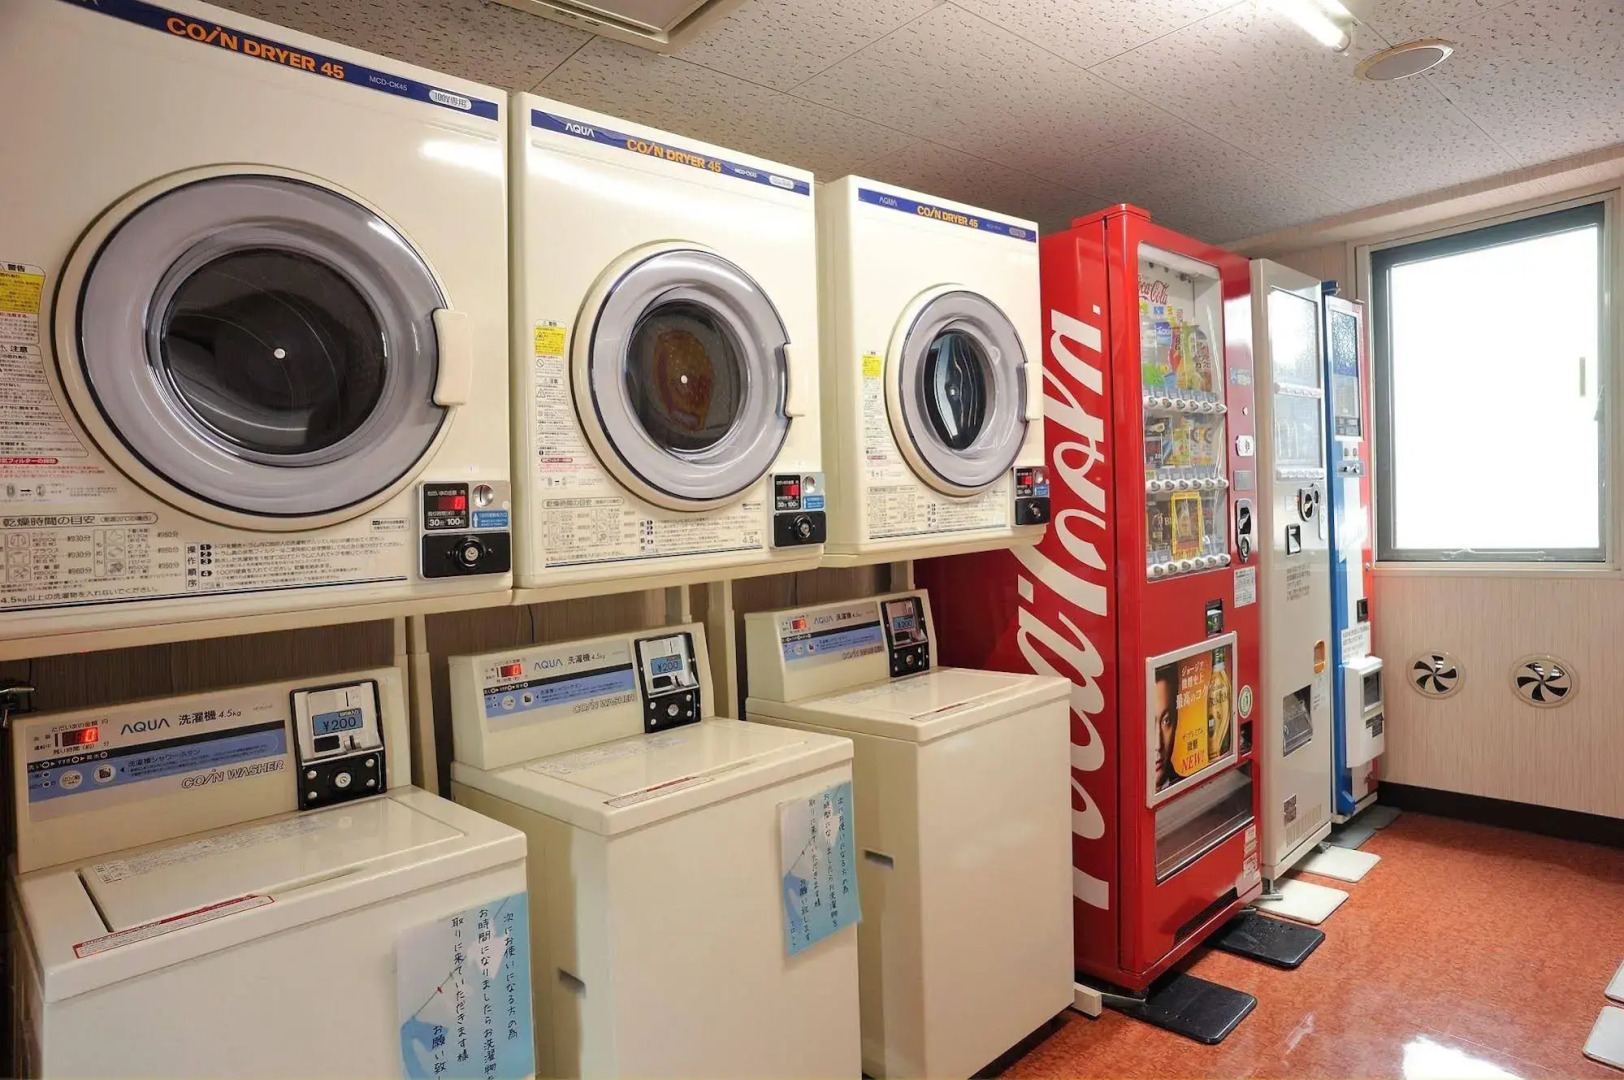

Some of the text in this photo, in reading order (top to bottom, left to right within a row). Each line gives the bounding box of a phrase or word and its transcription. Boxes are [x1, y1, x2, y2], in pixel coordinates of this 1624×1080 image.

[243, 37, 315, 72] DRYER
[320, 62, 344, 79] 45
[565, 122, 595, 138] AQUA
[666, 150, 706, 169] DRYER
[707, 160, 722, 173] 45
[878, 196, 898, 207] AQUA
[942, 211, 968, 226] DRYER
[968, 218, 979, 228] 45
[813, 615, 834, 625] AQUA
[533, 657, 563, 671] AQUA
[567, 653, 591, 666] 洗濯機
[657, 660, 679, 673] ¥200
[178, 709, 242, 726] 洗濯機 4.5kg
[322, 716, 357, 731] ¥200
[120, 718, 171, 736] AQUA
[85, 729, 95, 742] 0
[227, 759, 285, 780] WASHER
